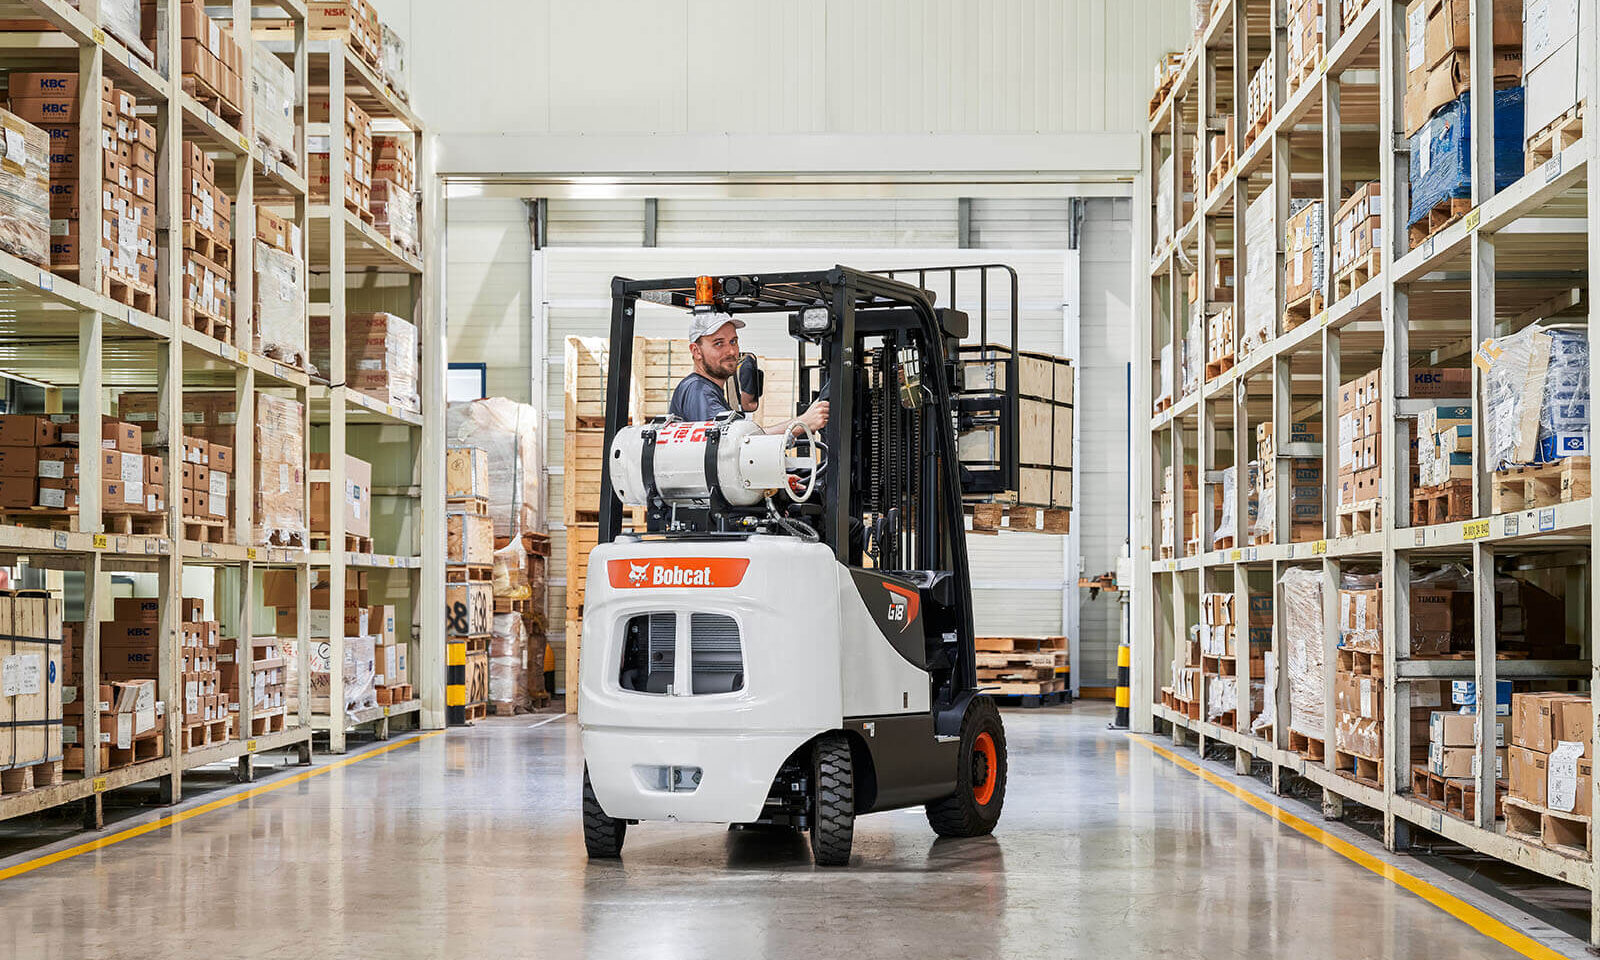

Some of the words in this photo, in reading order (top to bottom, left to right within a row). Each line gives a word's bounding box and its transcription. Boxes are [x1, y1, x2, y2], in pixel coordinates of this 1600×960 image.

[324, 8, 347, 16] NSK
[40, 79, 68, 88] KBC
[42, 103, 70, 113] KBC
[49, 128, 71, 139] BC
[1414, 373, 1442, 383] KBC
[653, 565, 712, 586] Bobcat
[1251, 598, 1272, 609] NT
[1416, 595, 1448, 603] TIMKEN
[141, 602, 159, 611] KB
[344, 600, 357, 608] SK
[888, 604, 904, 621] G18
[344, 616, 358, 624] SK
[128, 627, 152, 636] KBC
[1250, 630, 1272, 641] NT
[128, 653, 152, 662] KBC
